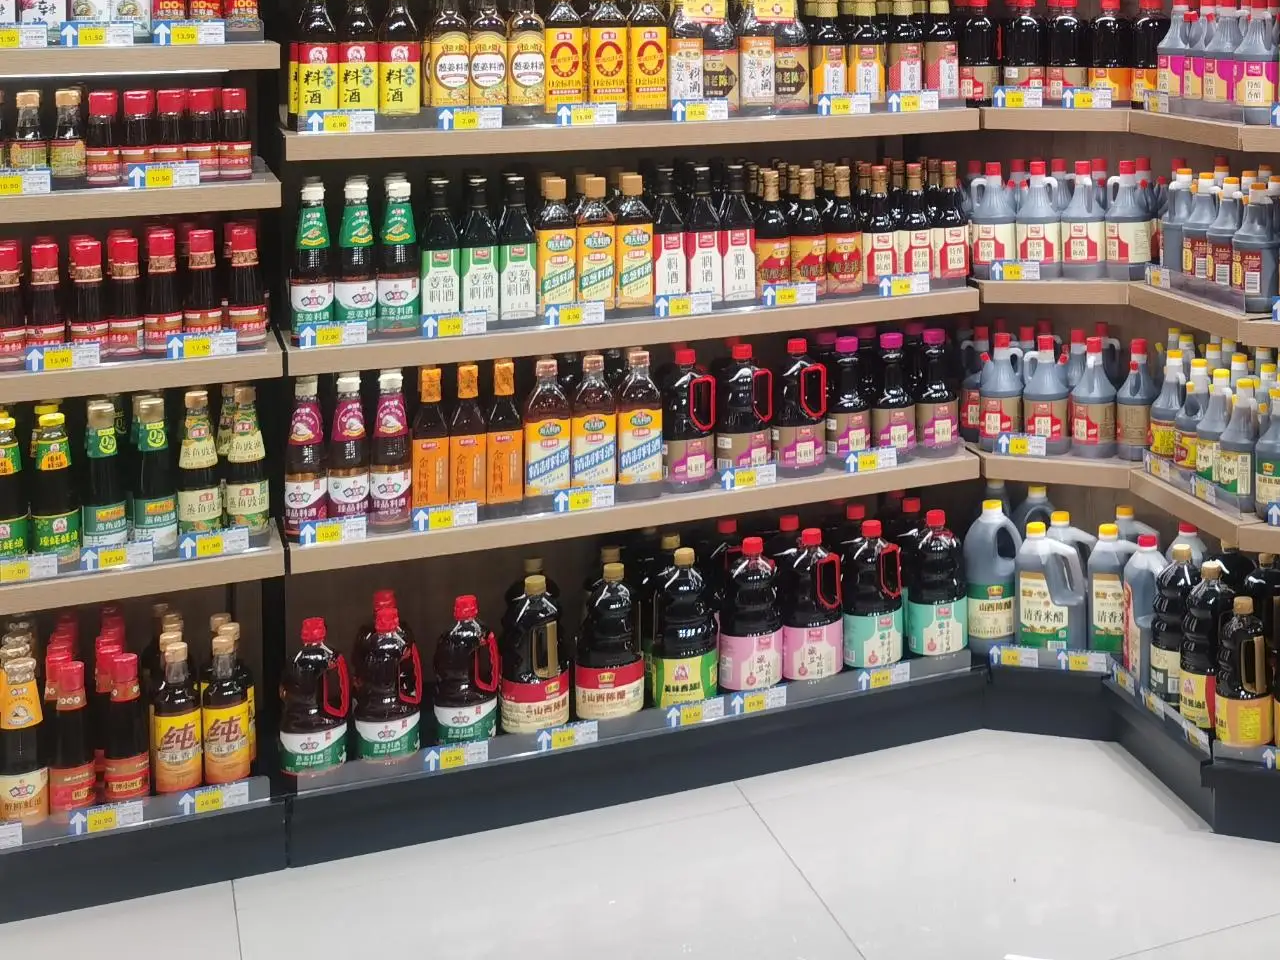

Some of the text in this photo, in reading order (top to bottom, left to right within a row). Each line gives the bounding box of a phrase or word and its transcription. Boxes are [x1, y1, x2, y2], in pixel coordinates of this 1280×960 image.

[304, 69, 324, 104] 料酒
[343, 68, 361, 103] 料酒
[385, 67, 404, 103] 料酒
[1024, 608, 1064, 624] 清香米醋
[162, 723, 198, 751] 纯
[207, 715, 242, 742] 纯
